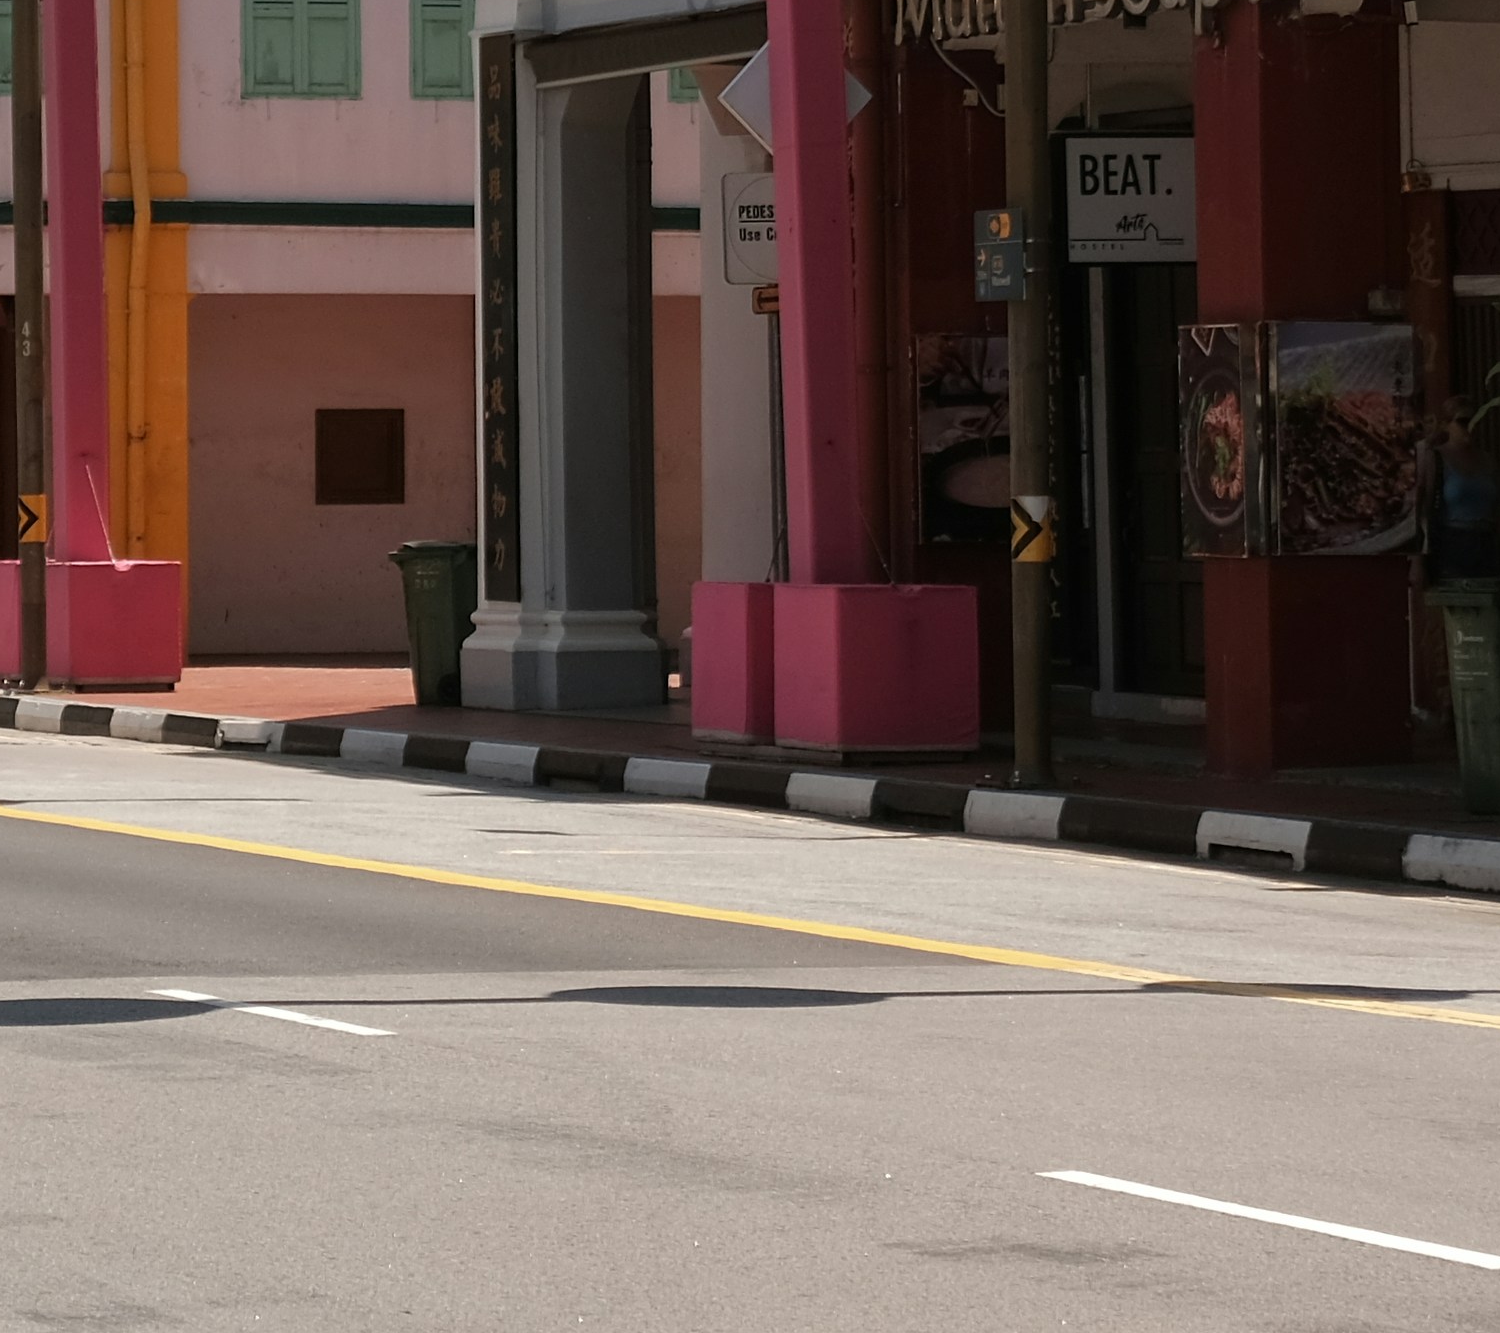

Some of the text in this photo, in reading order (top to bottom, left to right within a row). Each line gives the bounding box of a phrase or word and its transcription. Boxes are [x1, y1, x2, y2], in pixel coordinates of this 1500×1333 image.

[1079, 153, 1173, 196] BEAT.
[738, 204, 774, 219] PEDES
[739, 228, 761, 242] Use
[21, 321, 31, 357] 43
